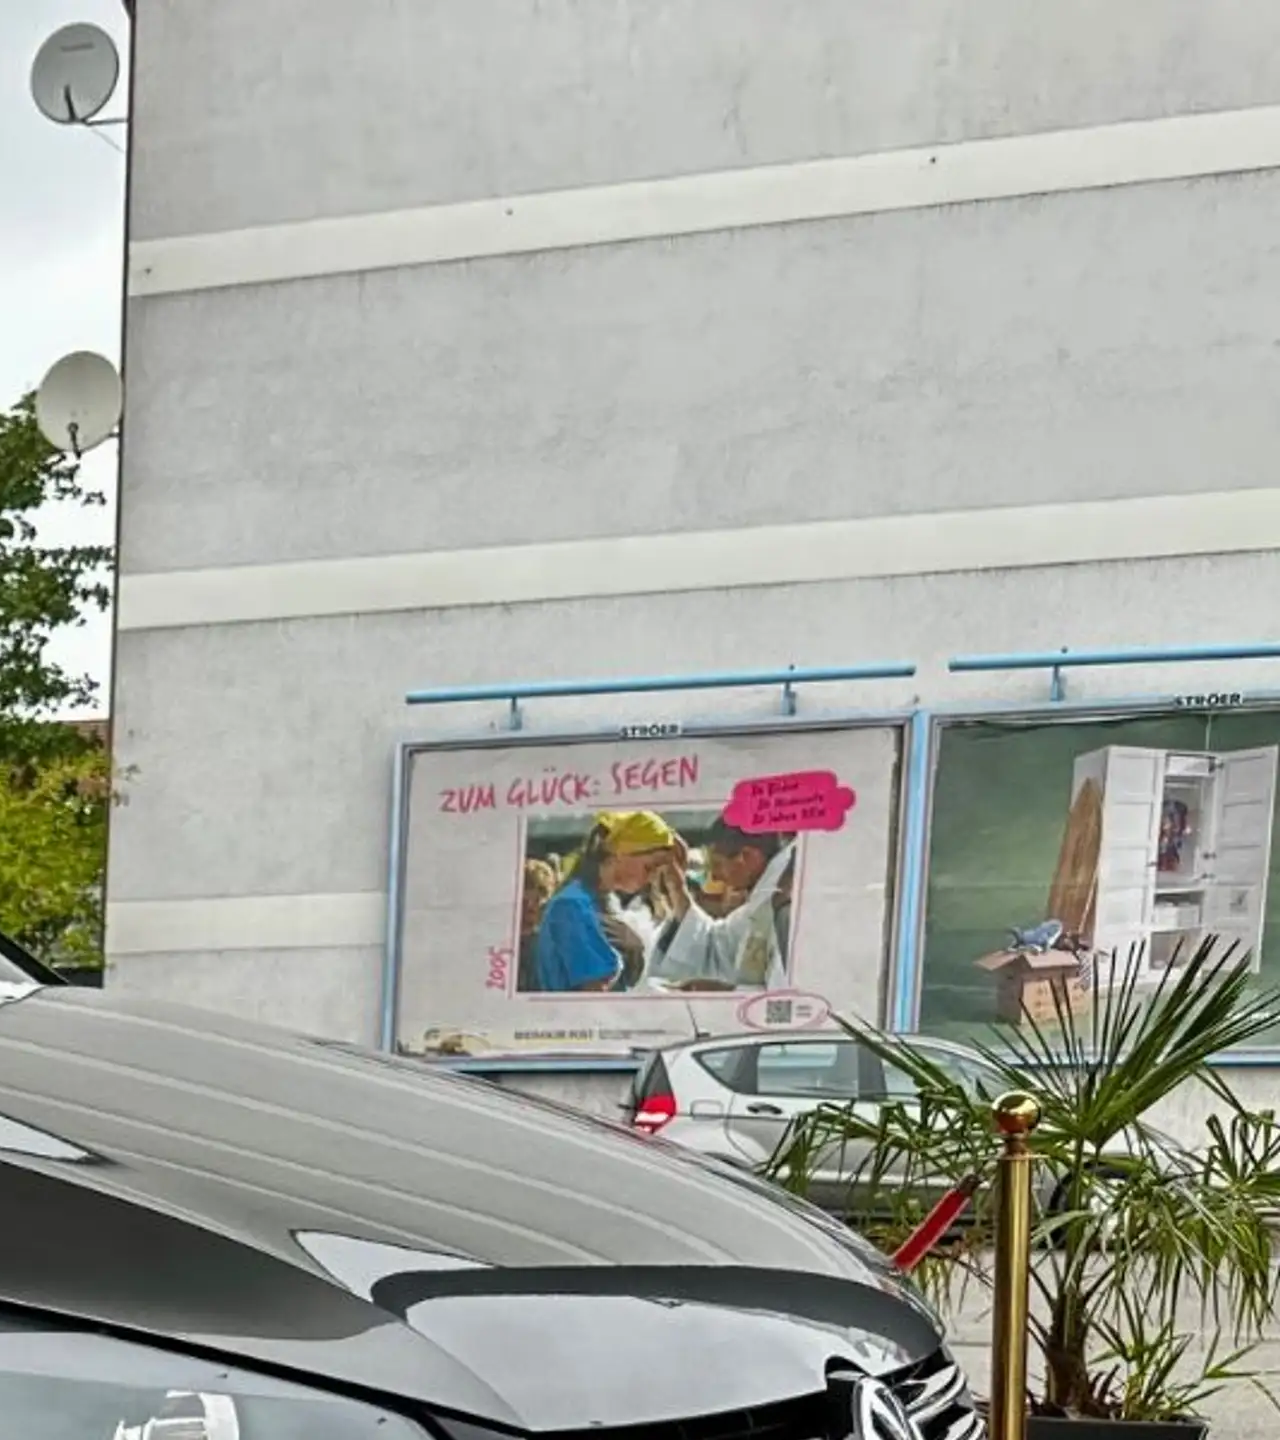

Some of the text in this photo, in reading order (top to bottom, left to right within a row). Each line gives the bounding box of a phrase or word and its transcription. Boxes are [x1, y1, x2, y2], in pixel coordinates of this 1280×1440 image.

[440, 753, 699, 813] ZUM GLÜCK: SEGEN
